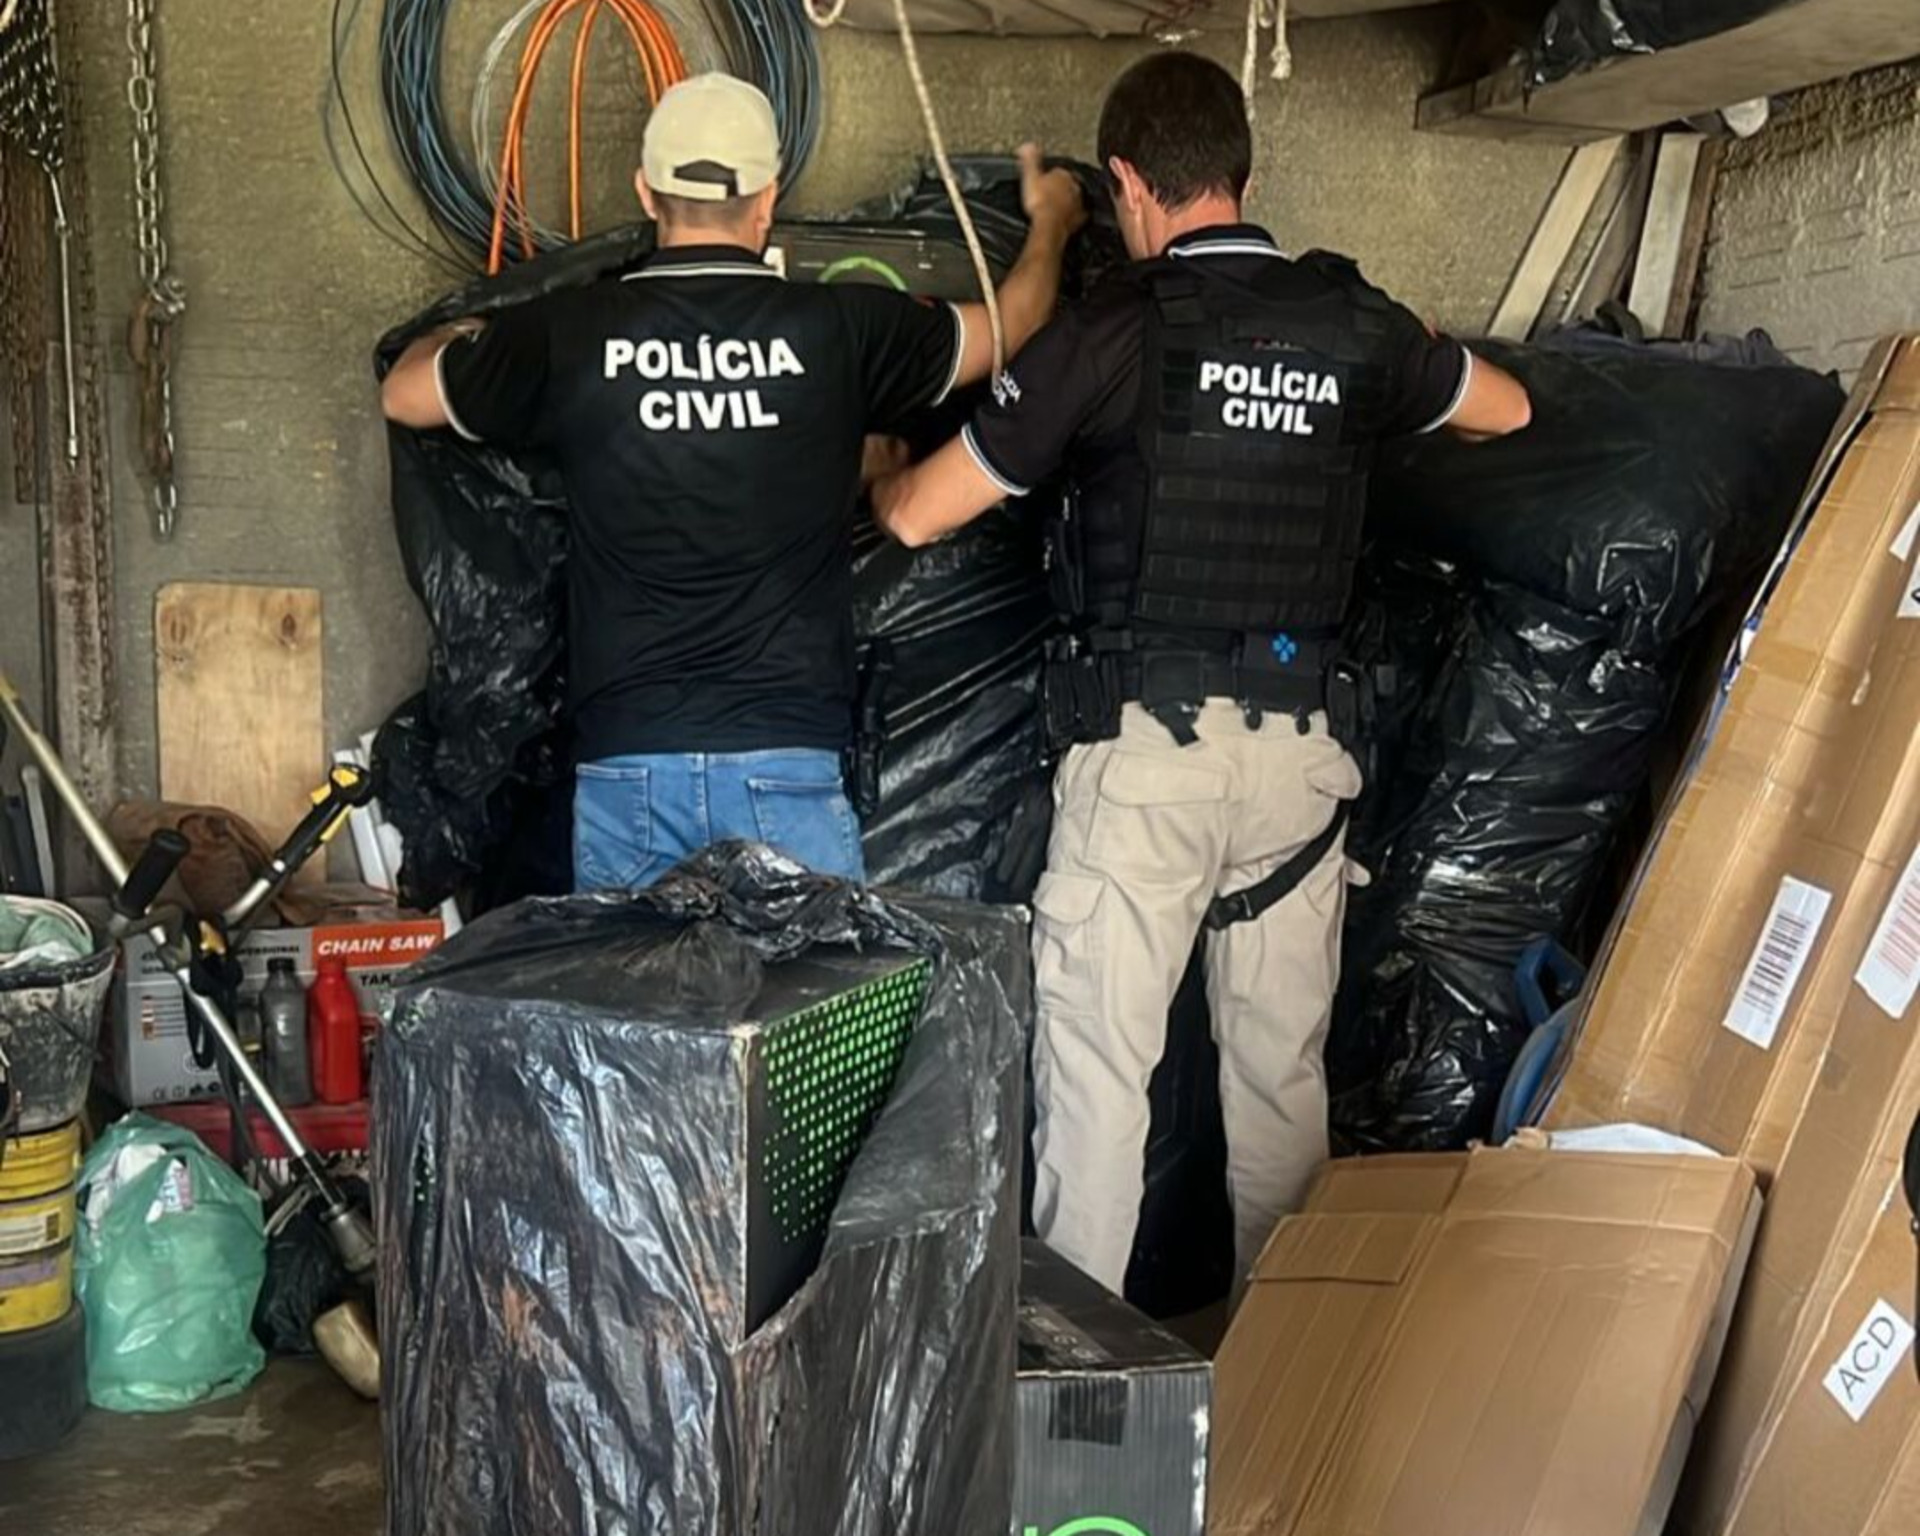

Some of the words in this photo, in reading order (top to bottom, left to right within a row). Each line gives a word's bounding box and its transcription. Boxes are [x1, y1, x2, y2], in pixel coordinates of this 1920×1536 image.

[604, 334, 805, 381] POLÍCIA
[1199, 361, 1339, 405] POLÍCIA
[639, 389, 780, 430] CIVIL
[1222, 397, 1313, 435] CIVIL
[318, 937, 385, 955] CHAIN
[389, 934, 436, 951] SAW
[1838, 1316, 1896, 1402] ACD
